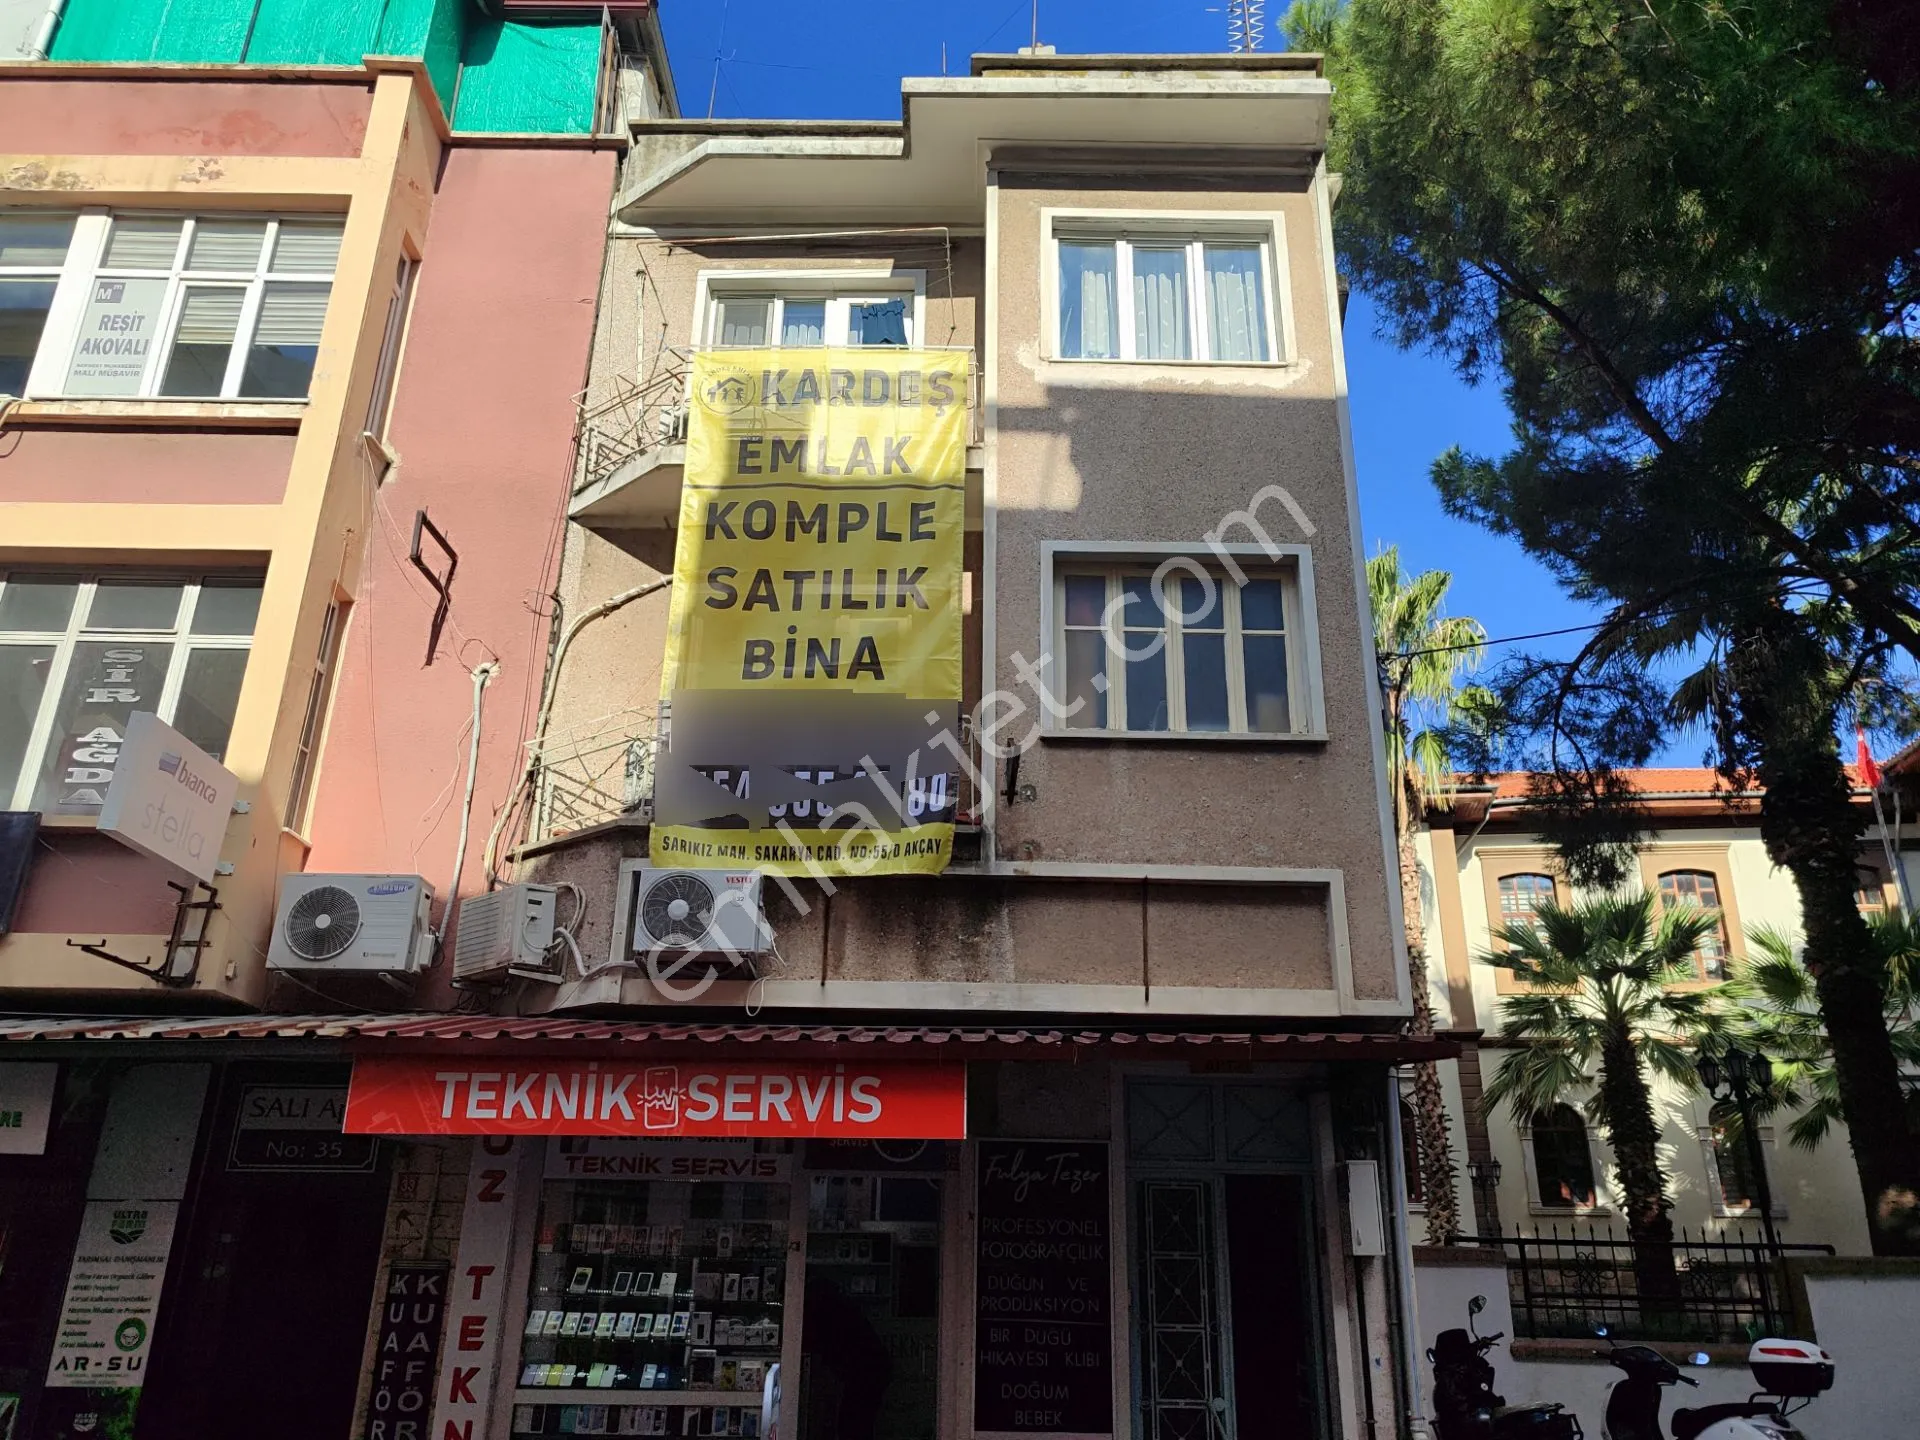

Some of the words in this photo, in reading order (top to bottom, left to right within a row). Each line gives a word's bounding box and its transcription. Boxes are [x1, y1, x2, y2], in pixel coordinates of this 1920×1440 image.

[98, 309, 146, 336] REŞİT
[79, 338, 150, 355] AKOVALI
[760, 367, 955, 418] KARDEŞ
[736, 434, 914, 477] EMLAK
[703, 498, 937, 544] KOMPLE
[704, 566, 930, 612] SATILIK
[741, 624, 886, 681] BİNA
[177, 756, 218, 804] bianca
[141, 793, 207, 862] stella
[662, 834, 713, 857] SARIKIZ
[717, 843, 750, 861] MAH.
[754, 844, 813, 862] SAKARYA
[903, 837, 943, 859] AKÇAY
[434, 1061, 638, 1121] TEKNİK
[684, 1063, 883, 1123] SERVİS
[249, 1096, 311, 1118] SALI
[264, 1140, 306, 1159] No:
[314, 1141, 343, 1159] 35
[564, 1152, 663, 1175] TEKNİK
[671, 1154, 779, 1177] SERVİS
[984, 1148, 1049, 1203] Fulya
[981, 1216, 1104, 1237] PROFESYONEL
[1066, 1277, 1090, 1292] VE
[1001, 1380, 1070, 1401] DOĞUM
[1014, 1409, 1064, 1426] BEBEK
